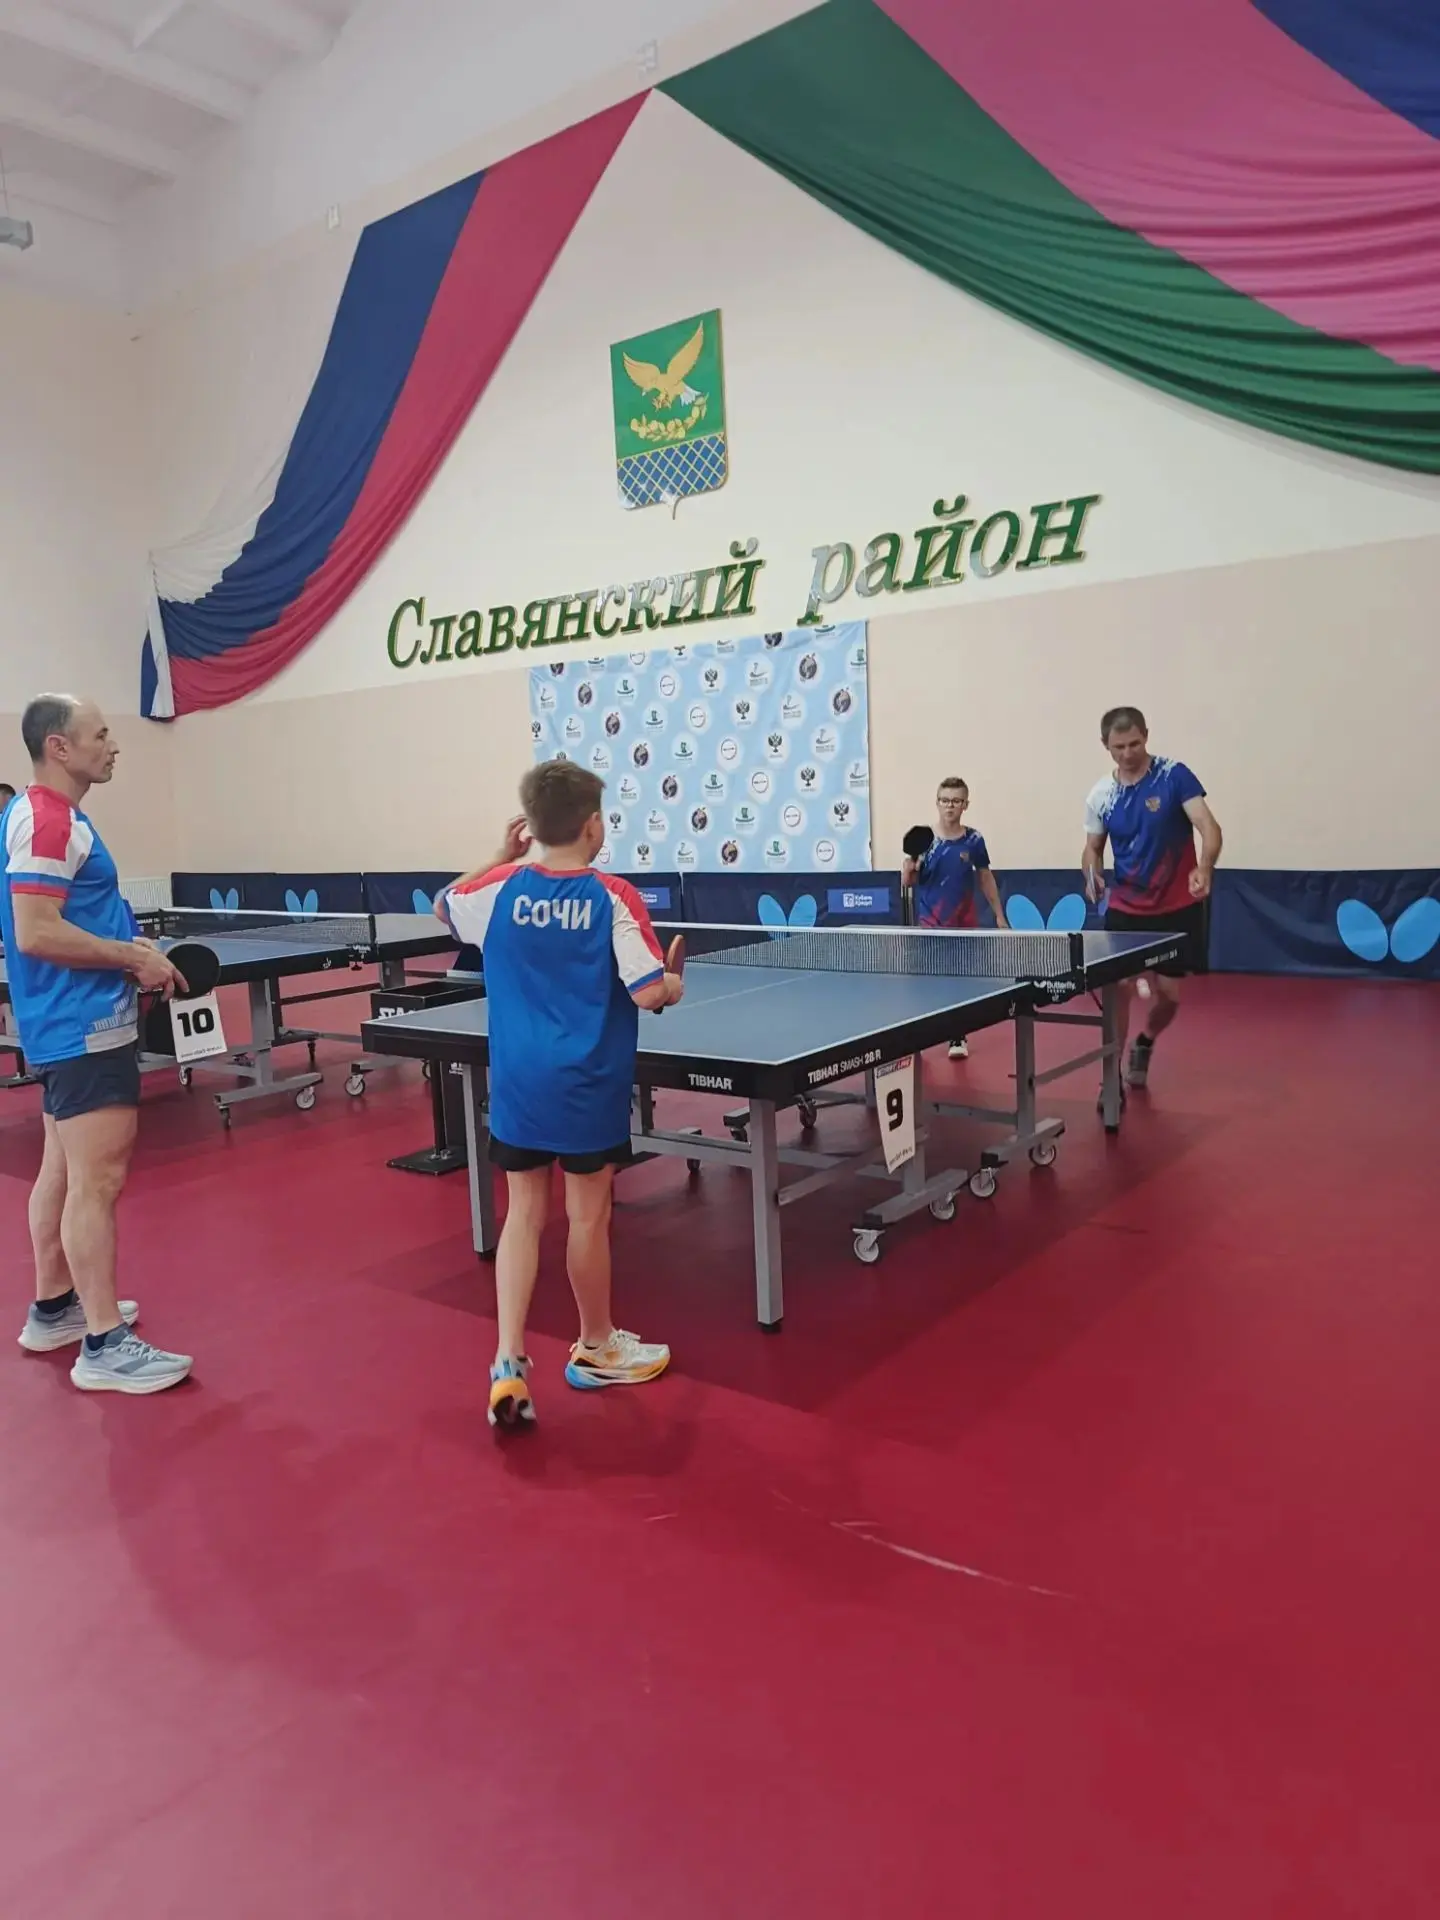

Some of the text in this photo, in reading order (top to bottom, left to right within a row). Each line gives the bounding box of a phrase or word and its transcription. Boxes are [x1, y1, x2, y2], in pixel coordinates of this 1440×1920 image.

[387, 494, 1101, 668] Славянский район
[512, 894, 592, 930] СОЧИ
[177, 1007, 215, 1037] 10
[688, 1073, 733, 1090] TIBHAR
[807, 1048, 882, 1084] TIBHAR SMASH 28 R
[886, 1088, 904, 1132] 9
